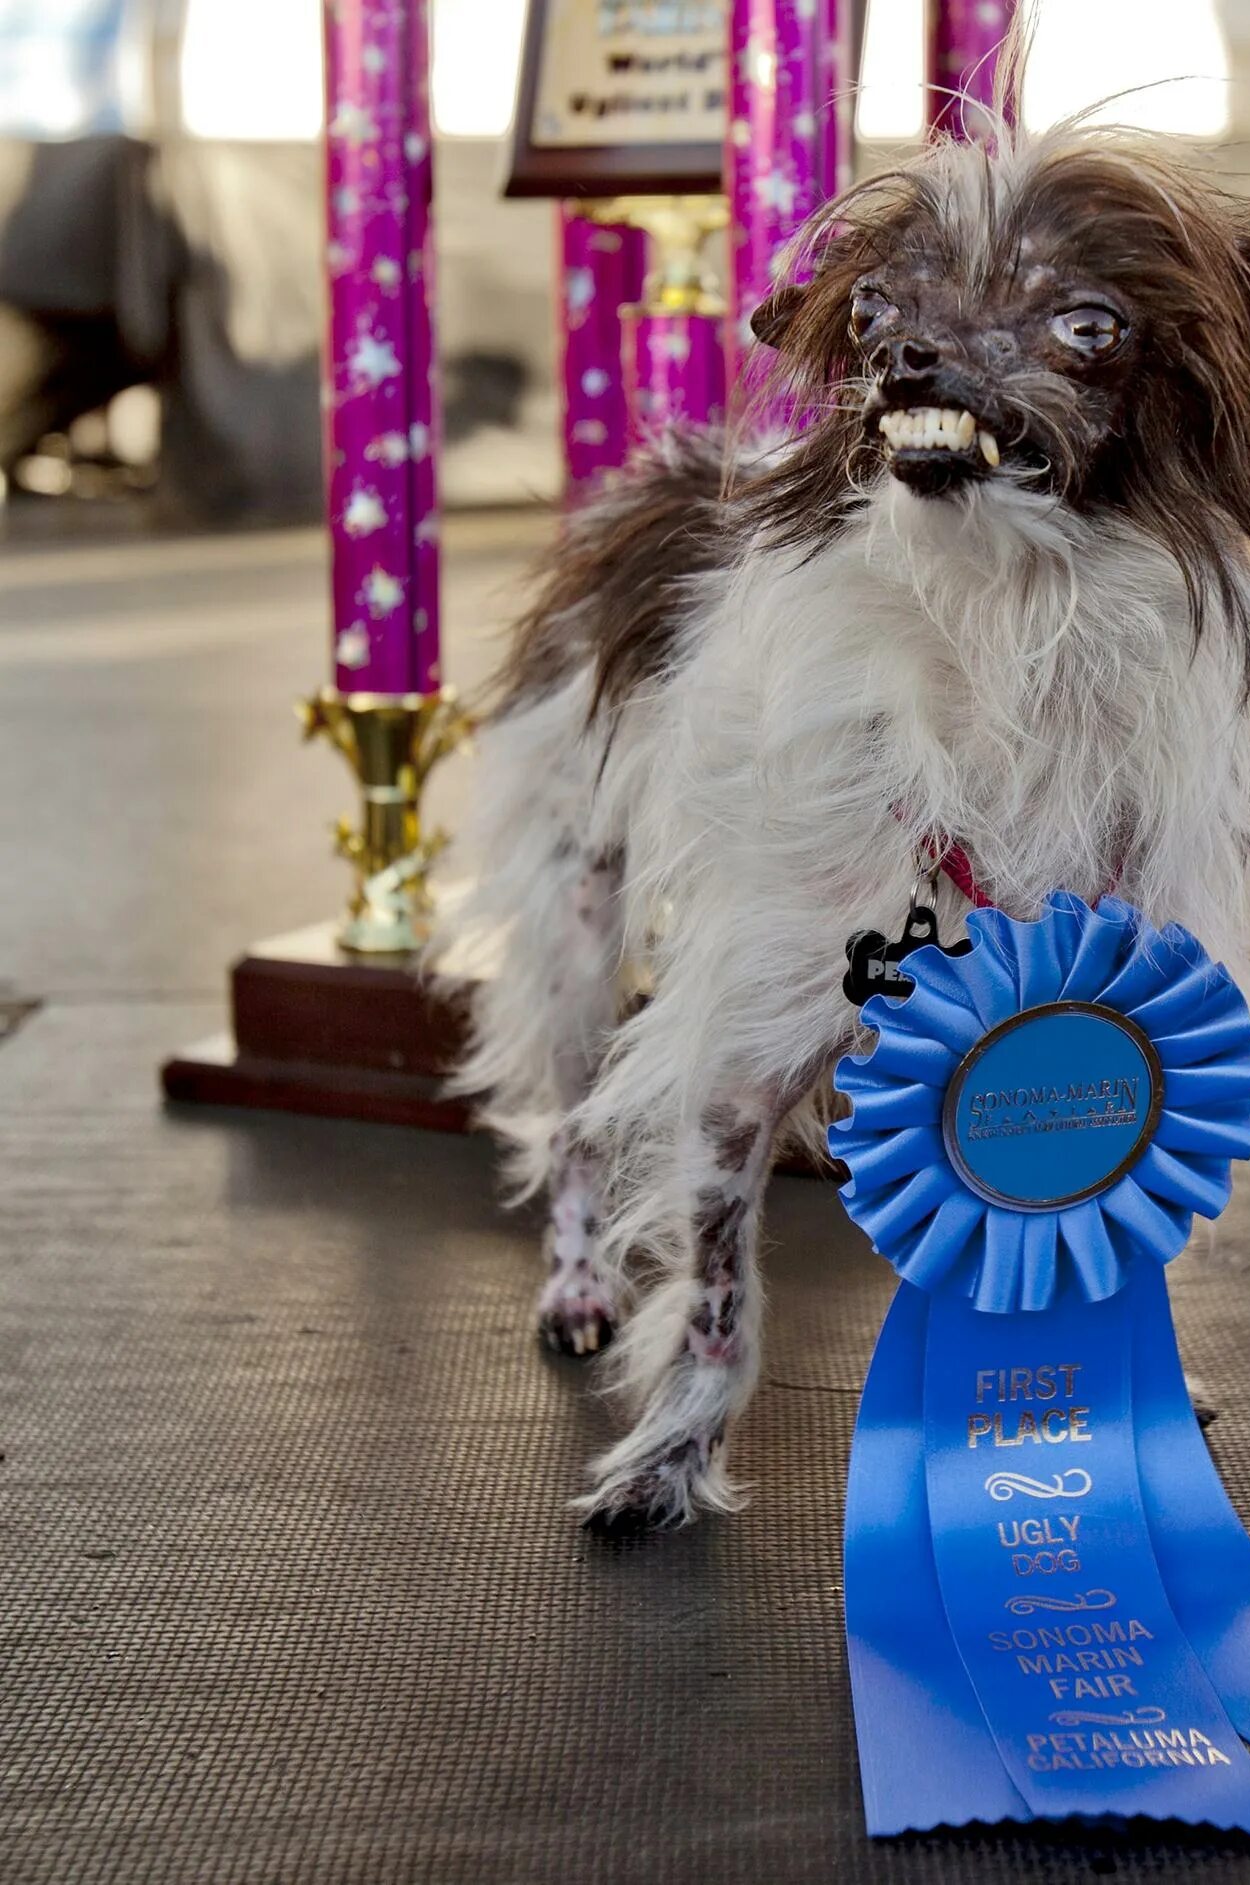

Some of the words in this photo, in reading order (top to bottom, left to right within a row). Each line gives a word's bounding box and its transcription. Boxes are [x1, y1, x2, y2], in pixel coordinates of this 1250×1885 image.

[867, 959, 914, 983] PE
[968, 1076, 1140, 1128] SONOMA-MARIN
[976, 1364, 1081, 1403] FIRST
[967, 1407, 1092, 1448] PLACE
[998, 1515, 1081, 1547] UGLY
[1012, 1549, 1081, 1576] DOG
[988, 1619, 1154, 1651] SONOMA
[1017, 1646, 1145, 1675] MARIN
[1050, 1674, 1138, 1700] FAIR
[1026, 1728, 1212, 1754] PETALUMA
[1027, 1747, 1232, 1771] CALIFORNIA
